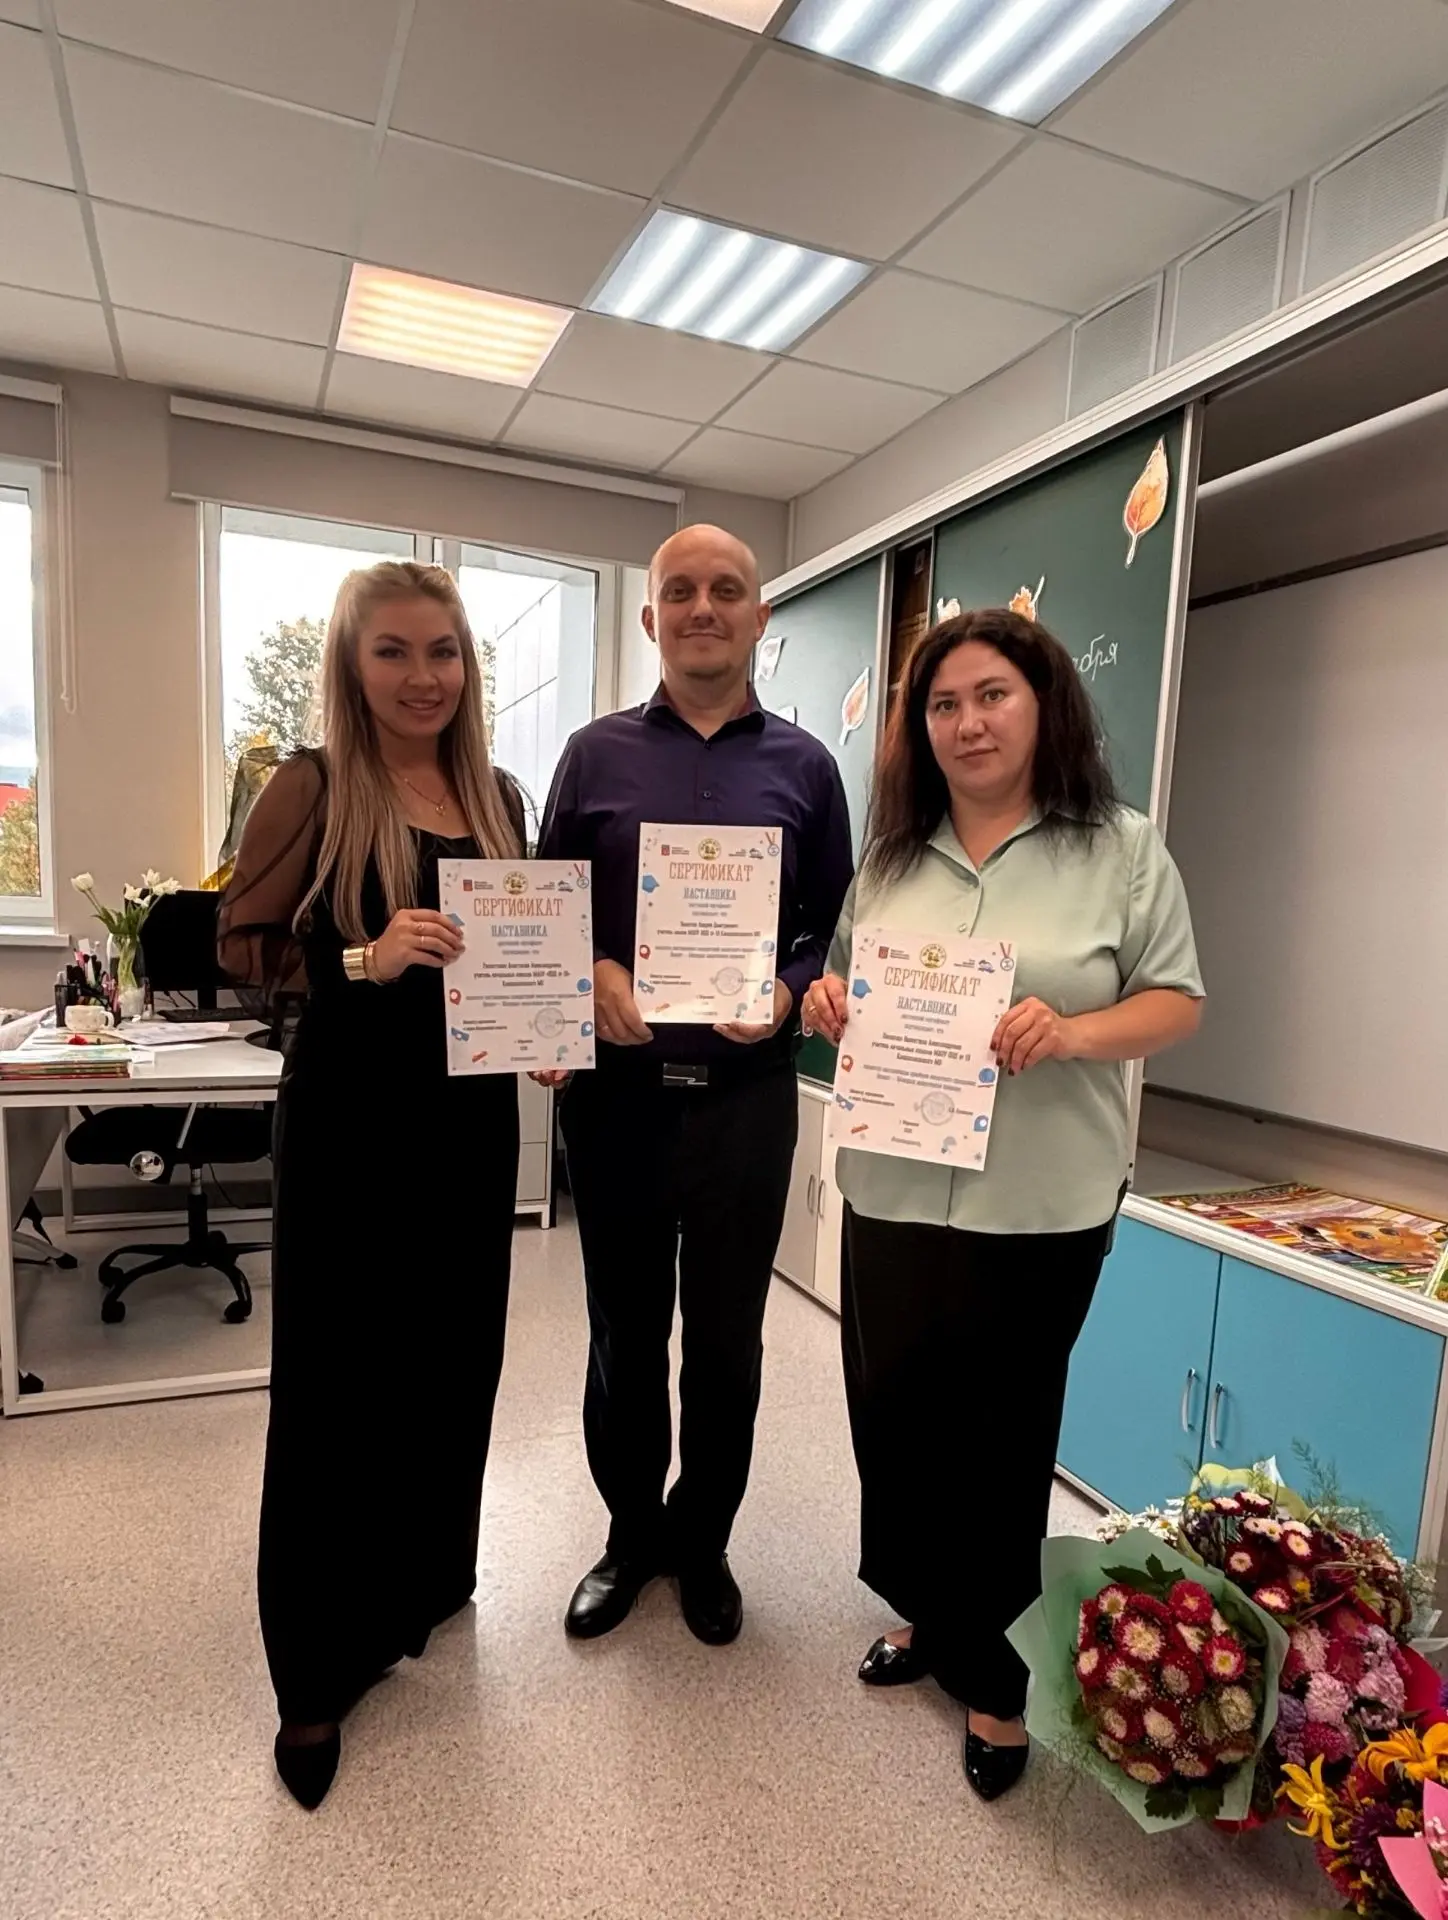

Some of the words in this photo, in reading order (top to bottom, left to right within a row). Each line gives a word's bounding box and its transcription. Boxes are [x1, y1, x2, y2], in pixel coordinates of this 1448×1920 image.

[669, 862, 753, 882] СЕРТИФИКАТ
[474, 898, 563, 917] СЕРТИФИКАТ
[884, 966, 981, 997] СЕРТИФИКАТ
[897, 996, 958, 1017] НАСТАВНИКА
